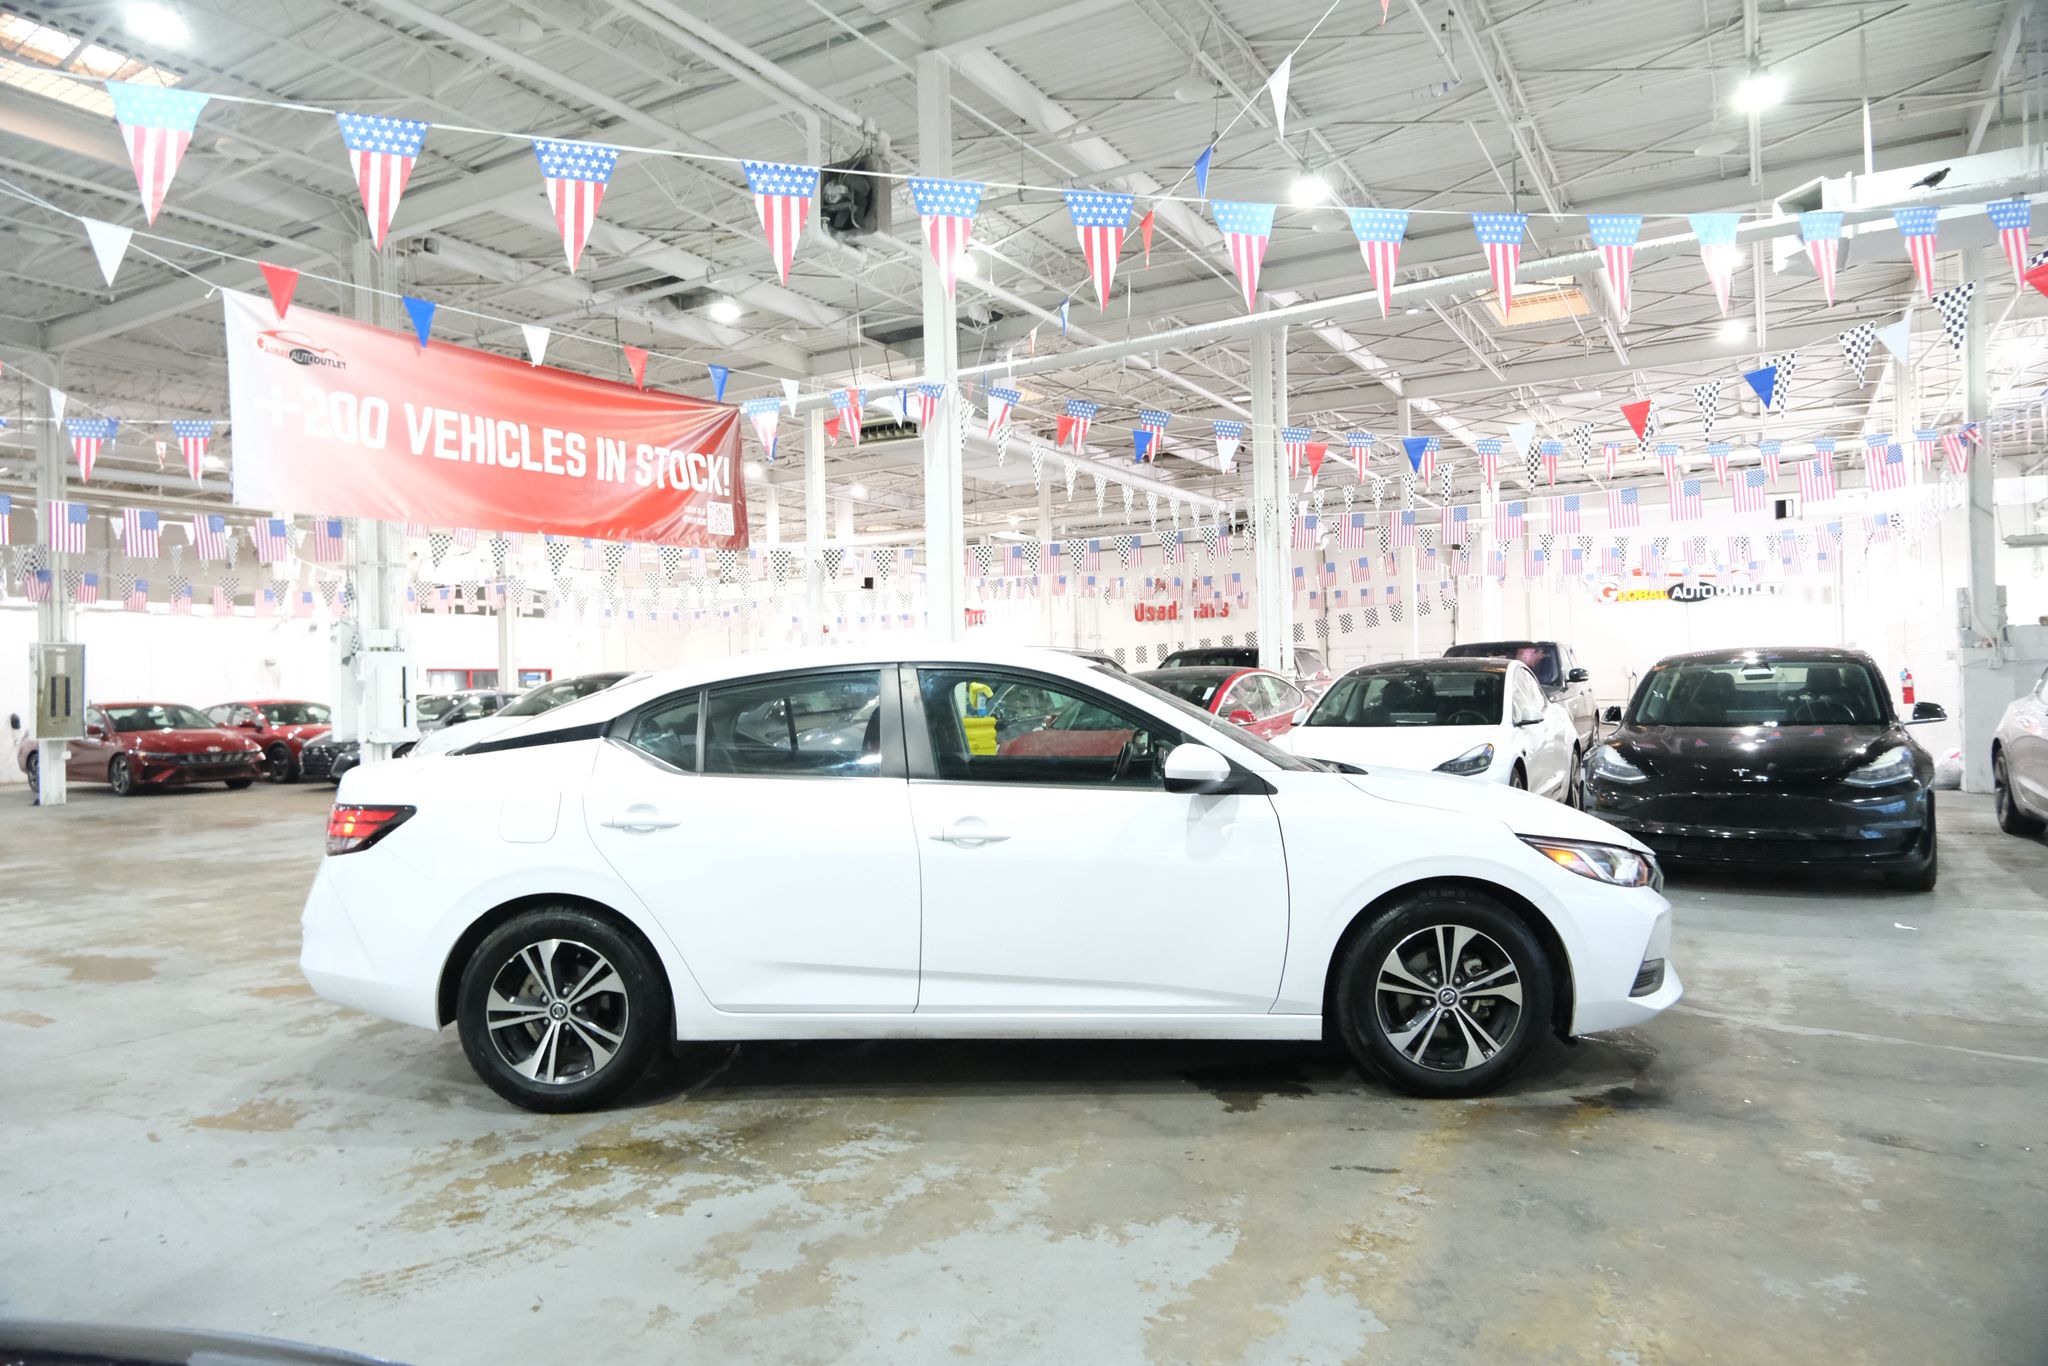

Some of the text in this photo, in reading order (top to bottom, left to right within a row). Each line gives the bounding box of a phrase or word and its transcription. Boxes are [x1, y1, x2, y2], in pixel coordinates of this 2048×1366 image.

[314, 355, 347, 369] OUTLET
[253, 384, 731, 497] +200 VEHICLES IN STOCK!
[1671, 584, 1714, 599] AUTO
[1716, 582, 1783, 597] OUTLET
[1134, 600, 1229, 622] Used ars
